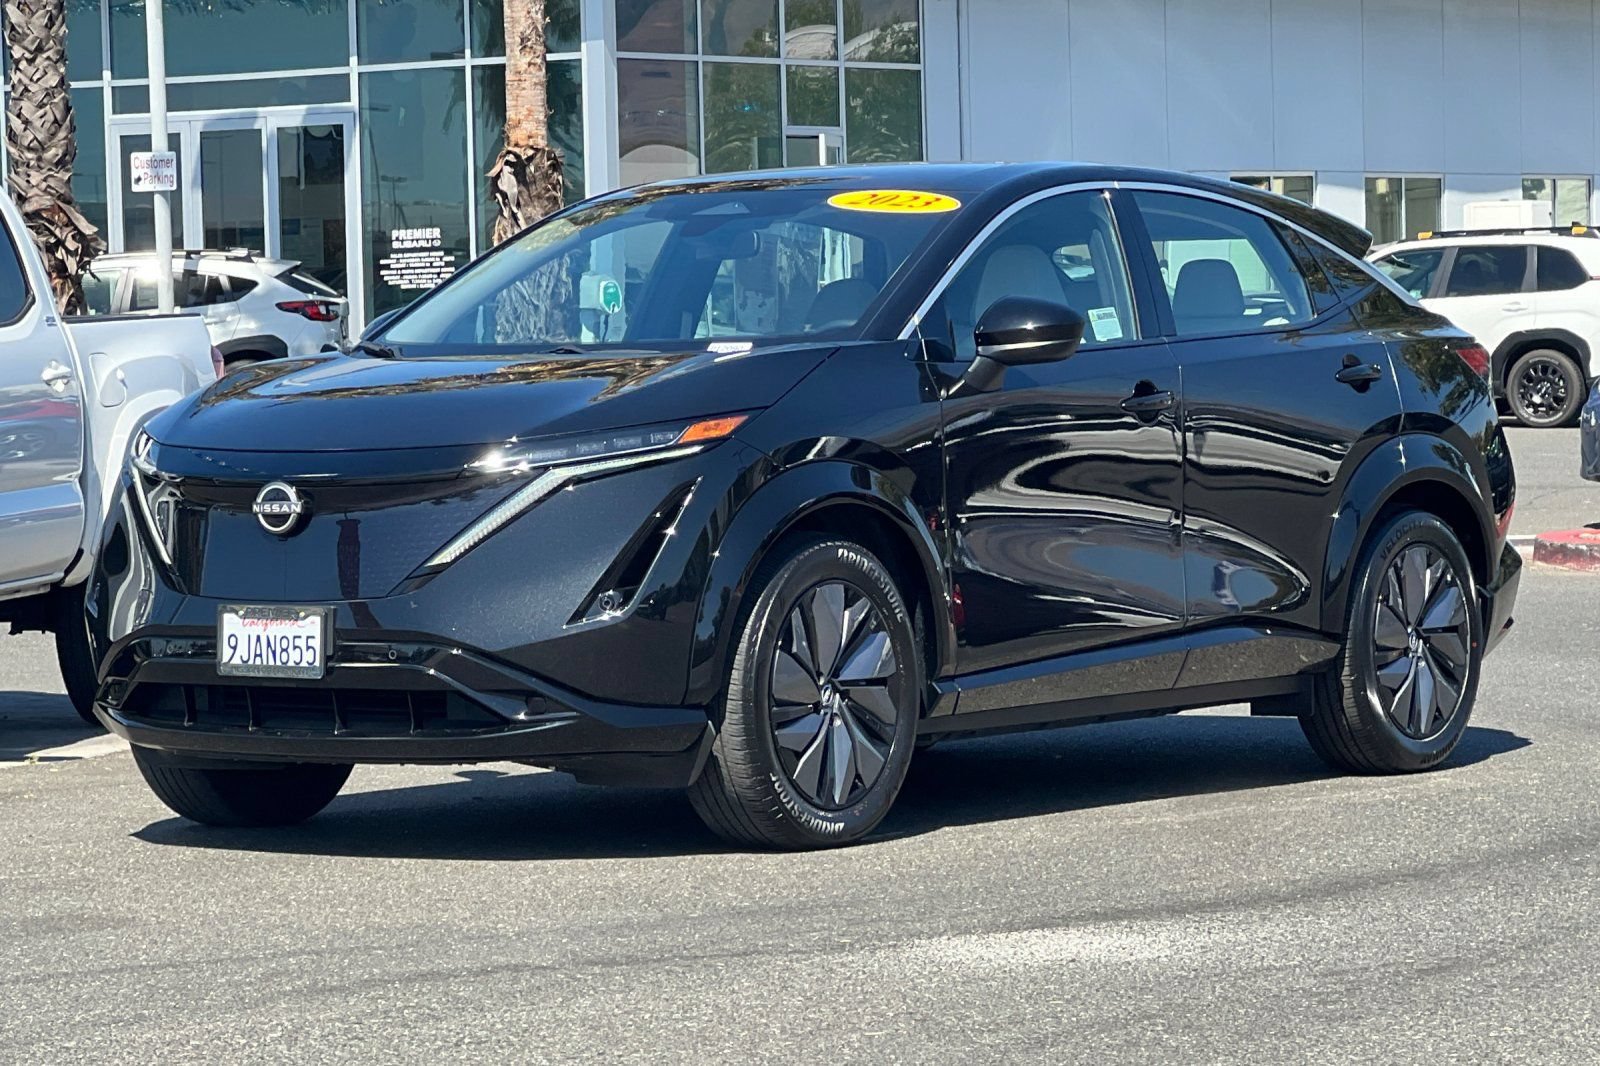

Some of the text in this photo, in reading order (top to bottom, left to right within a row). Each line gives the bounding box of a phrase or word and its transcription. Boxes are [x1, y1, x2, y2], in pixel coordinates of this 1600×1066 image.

[133, 156, 174, 169] Customer
[143, 171, 174, 187] Parking
[845, 193, 942, 208] 2023
[391, 227, 441, 240] PREMIER
[392, 239, 432, 249] SUBARU
[252, 503, 302, 513] NISSAN
[226, 633, 317, 666] 9JAN855
